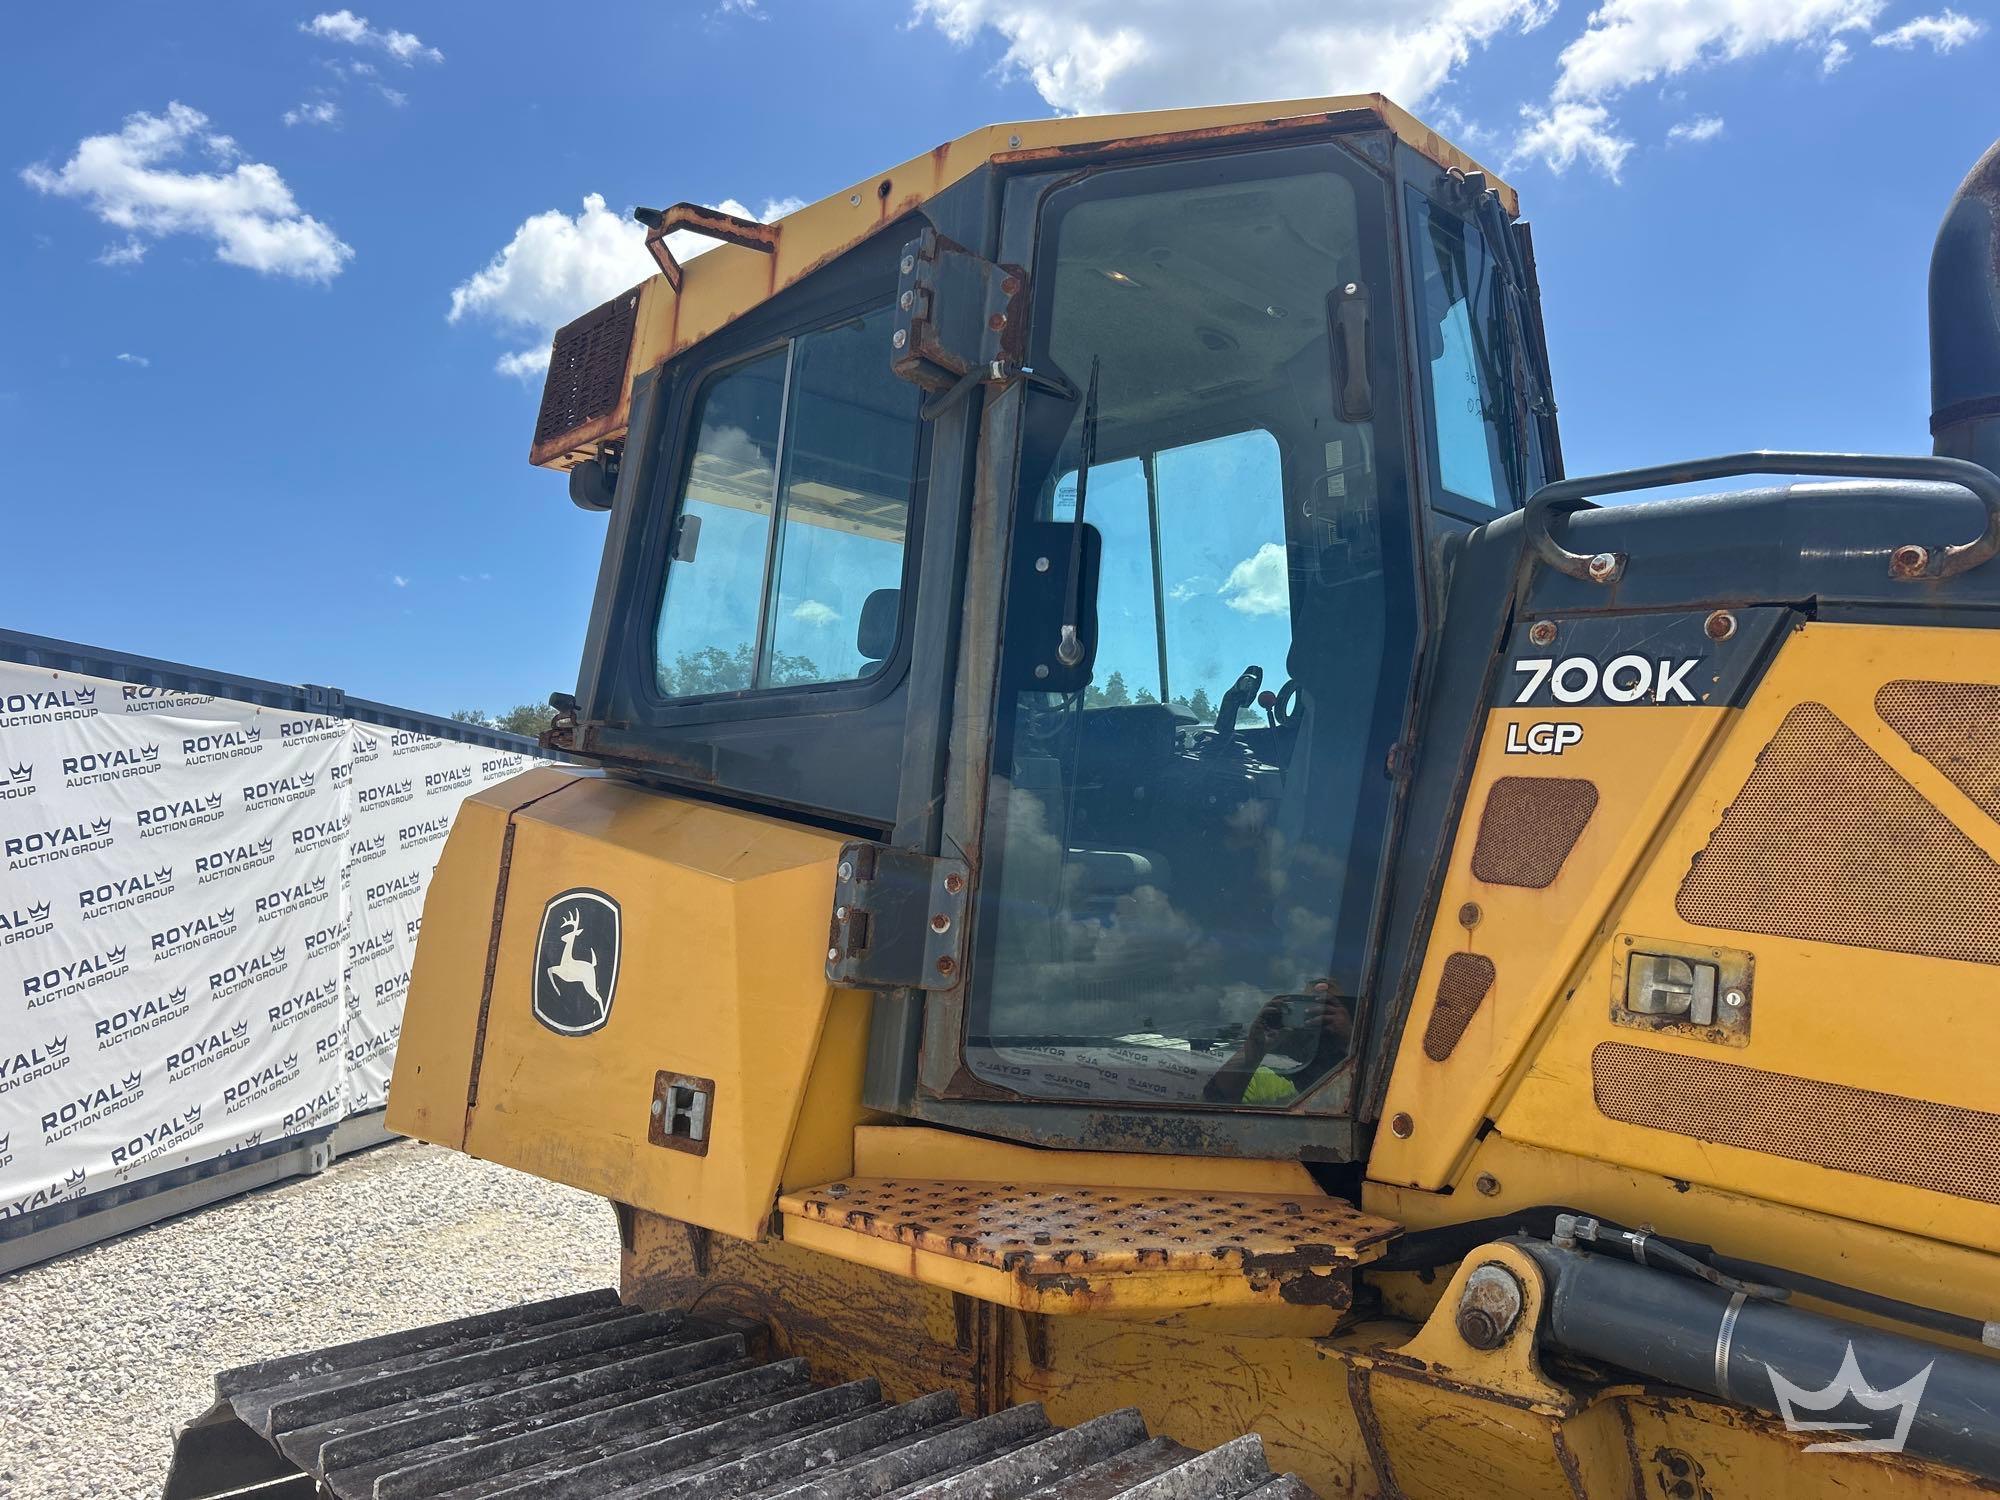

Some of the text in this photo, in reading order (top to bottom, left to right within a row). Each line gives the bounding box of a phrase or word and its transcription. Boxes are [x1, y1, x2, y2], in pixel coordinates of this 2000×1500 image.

[1515, 655, 1699, 702] 700K
[0, 708, 99, 728] UCTION GROUP
[126, 696, 215, 713] AUCTION GROUP
[280, 717, 334, 738] ROYAL
[1505, 722, 1583, 754] LGP
[182, 731, 246, 754] ROYAL
[282, 735, 319, 748] AUCTION
[392, 741, 442, 757] AUCTION GROUP
[62, 749, 141, 775] ROYAL
[185, 744, 263, 767] AUCTION GROUP
[354, 753, 379, 764] GROUP
[482, 757, 515, 773] ROYAL
[66, 764, 162, 789] AUCTION GROUP
[331, 762, 354, 780] ROY
[425, 768, 463, 787] ROYAL
[0, 785, 36, 800] ROUP
[243, 777, 301, 801] ROYAL
[245, 789, 316, 813] AUCTION GROUP
[358, 782, 402, 804] ROYAL
[426, 779, 473, 797] AUCTION GROUP
[136, 798, 206, 827] ROYAL
[360, 793, 414, 813] AUCTION GROUP
[139, 811, 224, 839] AUCTION GROUP
[292, 819, 343, 845] ROYAL
[399, 819, 439, 841] ROYAL
[5, 824, 92, 857] ROYAL
[294, 837, 331, 855] AUCTION
[350, 839, 374, 856] YAL
[400, 836, 428, 850] AUCTION
[8, 838, 114, 871] AUCTION GROUP
[195, 844, 258, 874] ROYAL
[362, 849, 386, 863] GROUP
[198, 855, 275, 885] AUCTION GROUP
[79, 874, 155, 908] ROYAL
[255, 883, 312, 913] ROYAL
[366, 876, 410, 902] ROYAL
[368, 885, 421, 911] AUCTION GROUP
[82, 885, 175, 921] AUCTION GROUP
[258, 892, 329, 924] AUCTION GROUP
[4, 922, 54, 945] GROUP
[151, 916, 219, 951] ROYAL
[154, 925, 237, 963] AUCTION GROUP
[307, 941, 341, 960] AUCTION
[349, 936, 383, 960] OYAL
[371, 944, 395, 960] GROUP
[23, 955, 107, 997] ROYAL
[209, 954, 271, 990] ROYAL
[212, 963, 288, 1002] AUCTION GROUP
[375, 971, 410, 998] ROYA
[27, 965, 129, 1010] AUCTION GROUP
[376, 988, 406, 1007] AUCTION
[95, 996, 170, 1039] ROYAL
[268, 987, 324, 1023] ROYAL
[271, 994, 339, 1033] AUCTION GROUP
[98, 1005, 190, 1051] AUCTION GROUP
[166, 1031, 232, 1072] ROYAL
[346, 1031, 390, 1061] ROYAL
[378, 1039, 398, 1056] GROU
[0, 1049, 46, 1079] YAL
[23, 1057, 70, 1084] GROUP
[169, 1037, 251, 1084] AUCTION GROUP
[223, 1063, 284, 1105] ROYAL
[226, 1069, 300, 1116] AUCTION GROUP
[41, 1083, 123, 1133] ROYAL
[45, 1090, 144, 1146] AUCTION GROUP
[283, 1090, 336, 1130] ROYAL
[284, 1113, 322, 1138] AUCTION
[322, 1101, 340, 1117] GRO
[111, 1117, 185, 1166] ROYAL
[114, 1122, 204, 1178] AUCTION GROUP
[0, 1183, 62, 1219] OYAL
